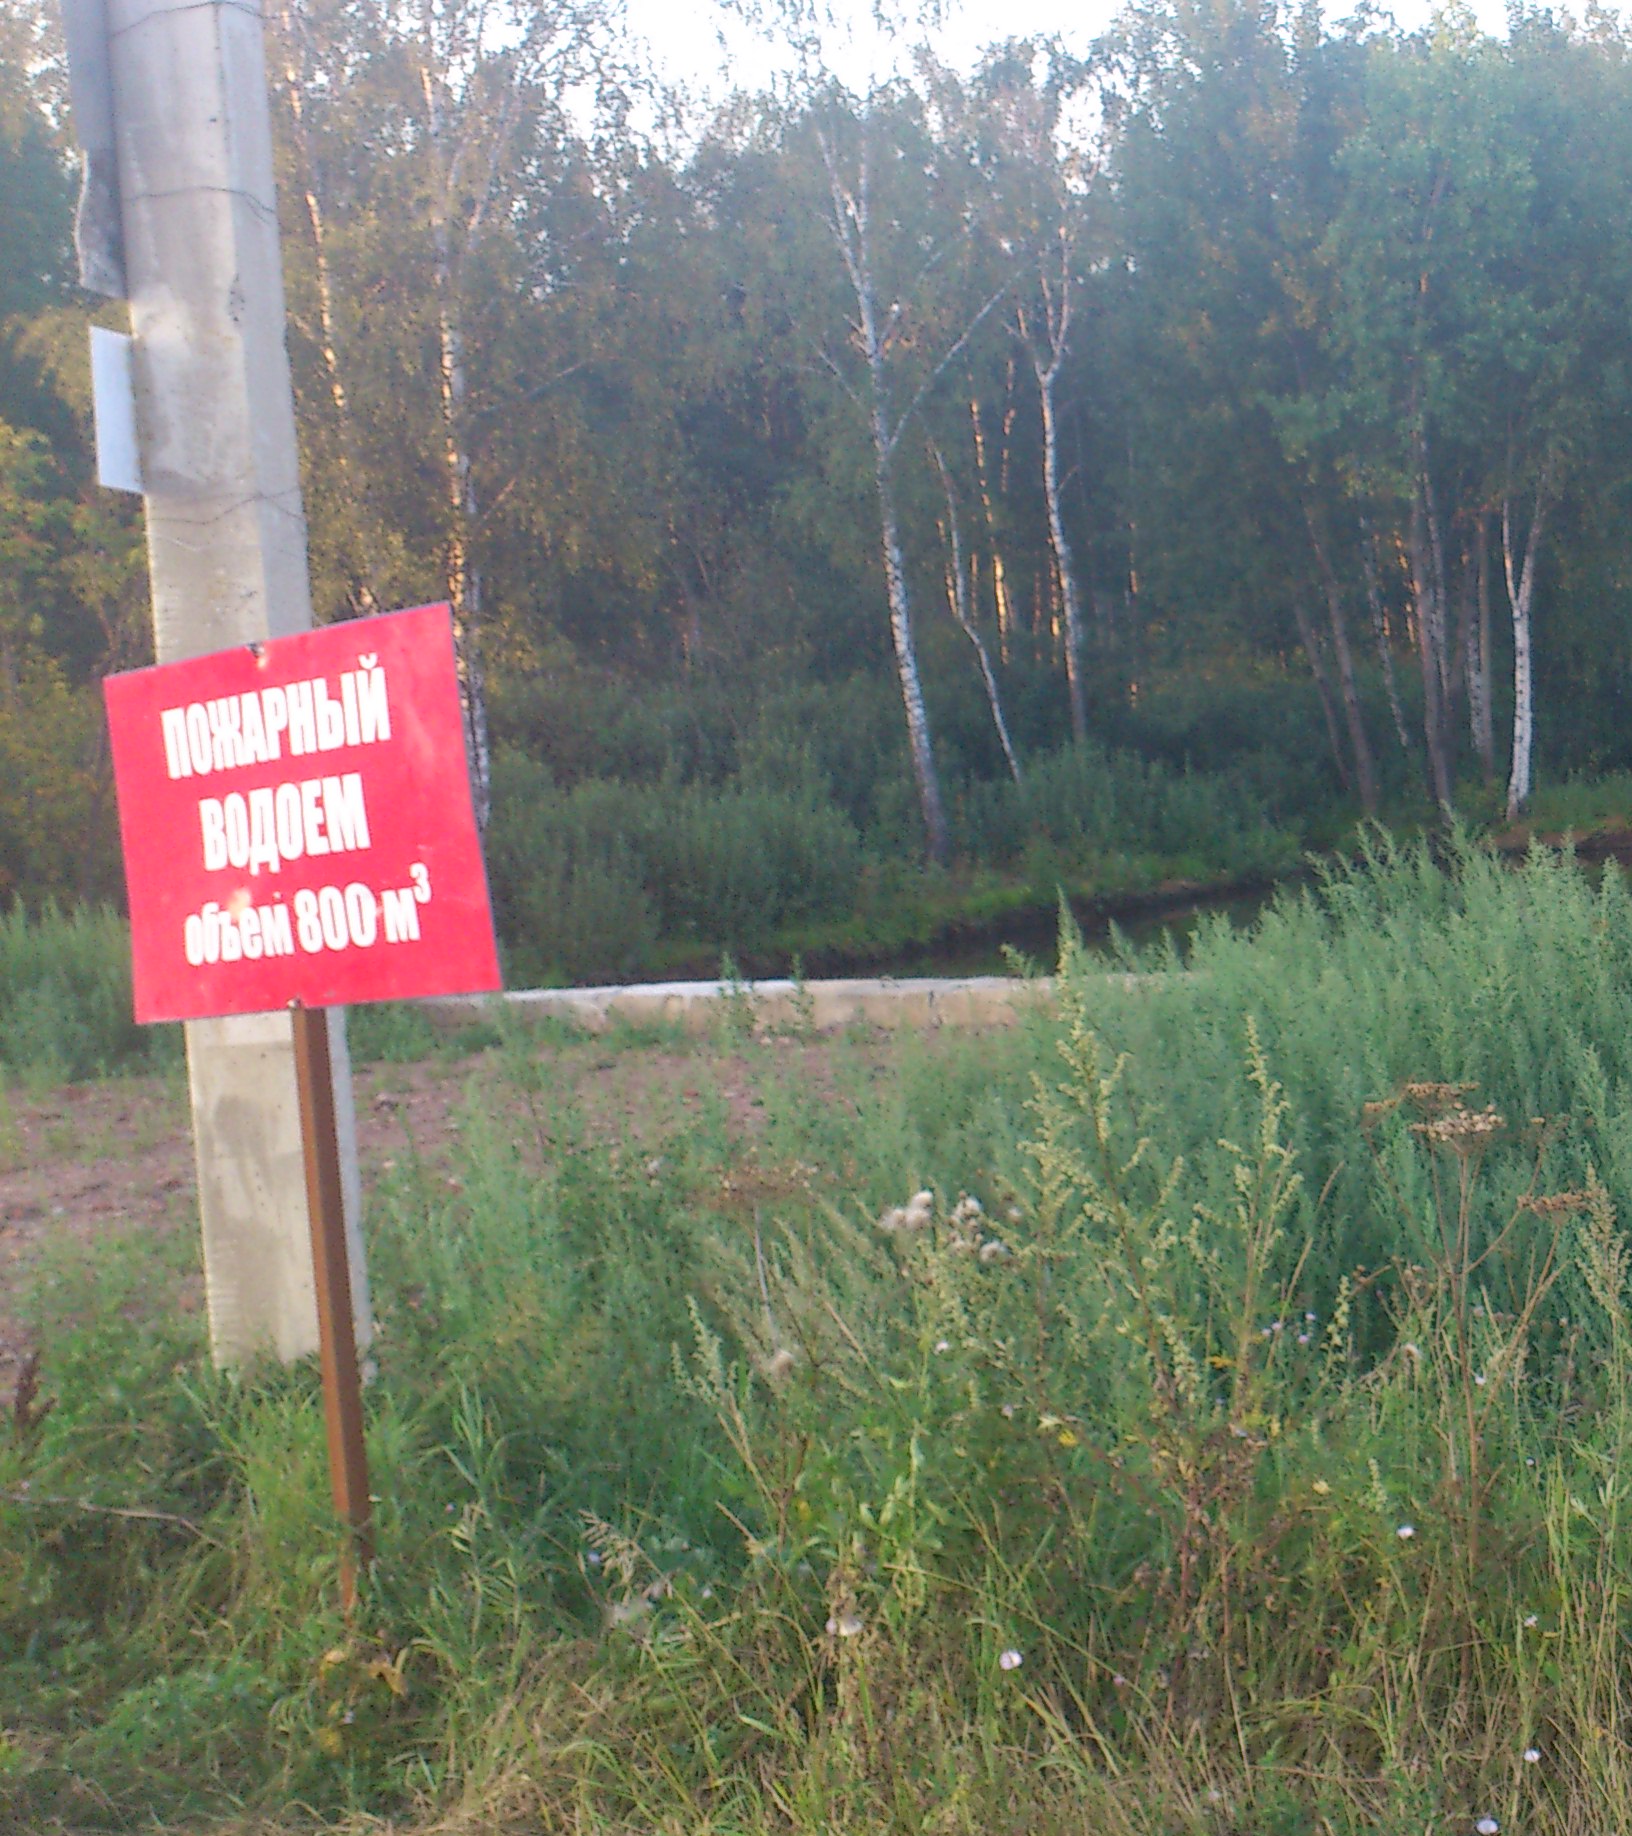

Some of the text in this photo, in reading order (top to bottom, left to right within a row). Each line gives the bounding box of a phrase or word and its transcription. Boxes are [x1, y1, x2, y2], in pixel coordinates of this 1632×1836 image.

[160, 653, 391, 779] ПОЖАРНЫЙ
[199, 773, 371, 876] ВОДОЕМ
[294, 882, 378, 955] 800
